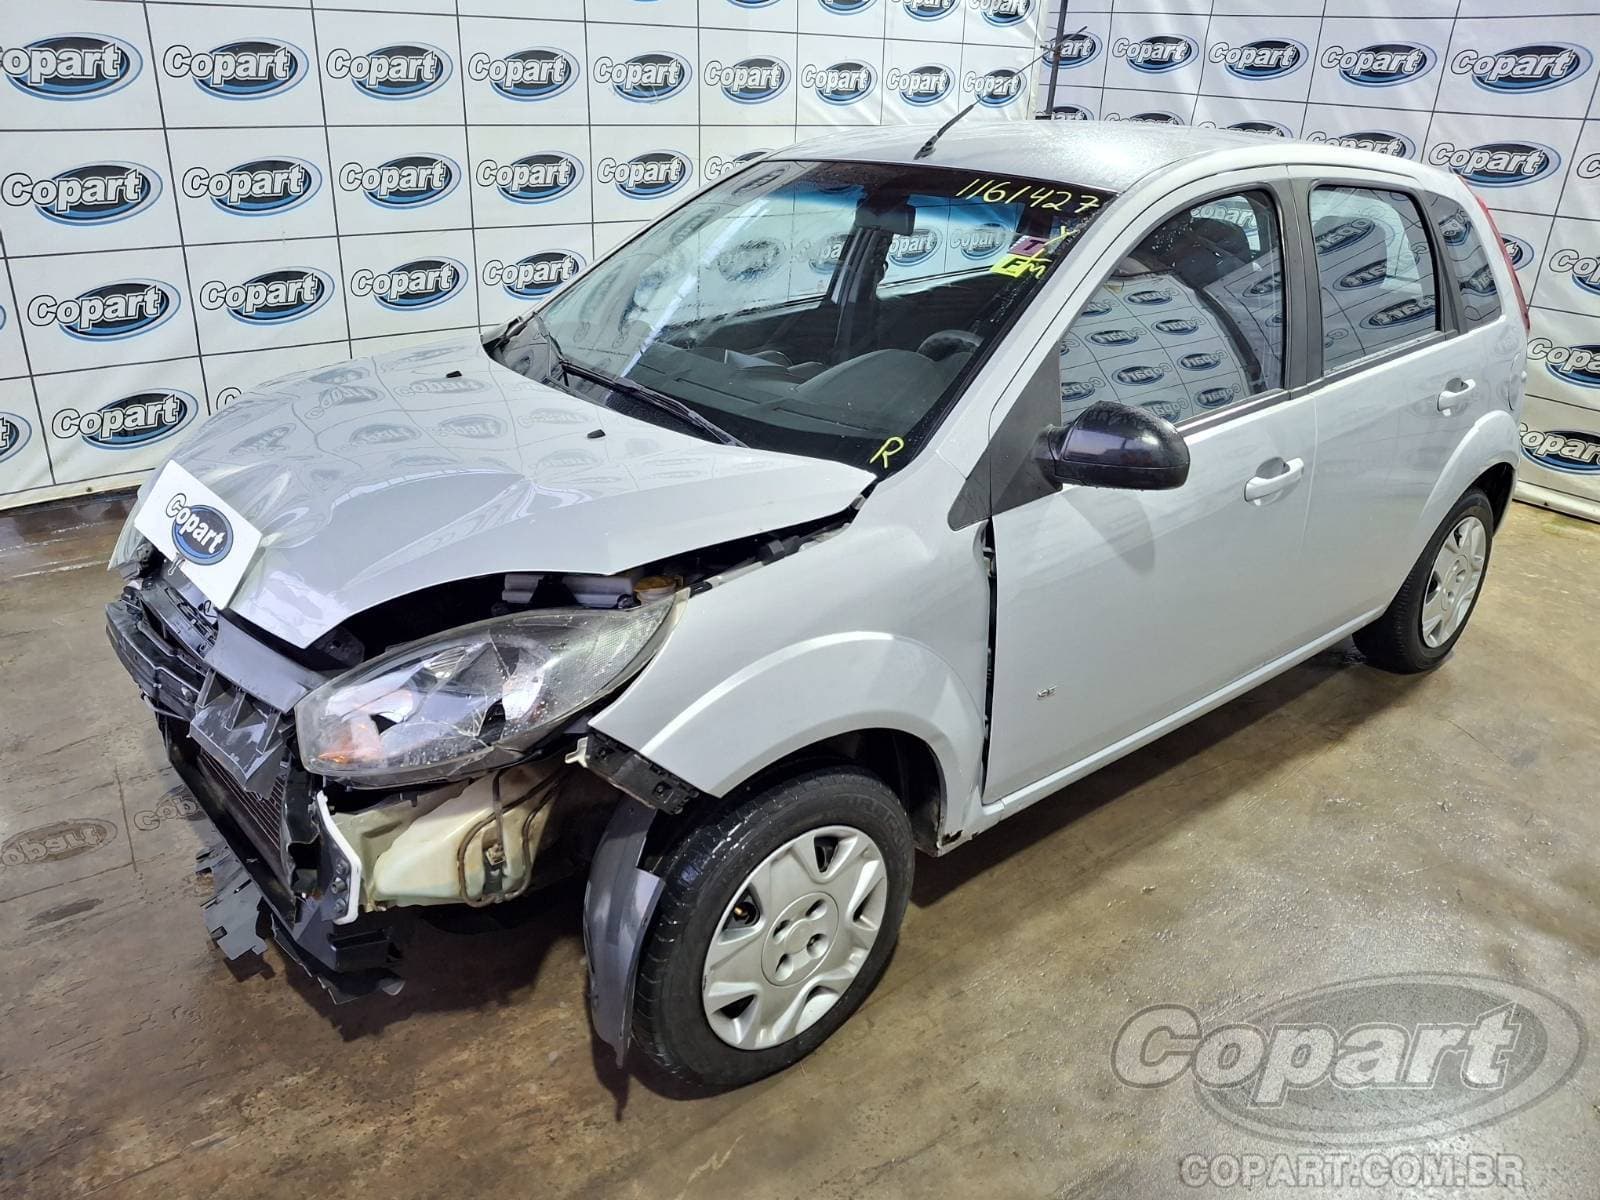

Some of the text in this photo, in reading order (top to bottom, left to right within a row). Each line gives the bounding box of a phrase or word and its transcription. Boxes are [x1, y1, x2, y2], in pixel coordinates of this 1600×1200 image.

[0, 43, 122, 85] opart
[163, 44, 290, 87] Copart
[326, 49, 437, 87] Copart
[1112, 38, 1188, 63] Copart
[1209, 43, 1297, 69] Copart
[1321, 46, 1425, 75] Copart
[1451, 49, 1576, 82] Copart
[468, 52, 567, 88] Copart
[594, 56, 679, 90] Copart
[704, 61, 781, 93] Copart
[801, 64, 869, 94] Copart
[886, 68, 948, 95] Copart
[963, 72, 1020, 96] Copart
[476, 157, 571, 193] Copart
[597, 155, 681, 190] Copart
[1429, 143, 1546, 175] Copart
[2, 170, 143, 213] Copart
[182, 164, 304, 205] Copart
[339, 160, 447, 199] Copart
[955, 178, 1100, 213] 1161427
[351, 262, 453, 303] Copart
[483, 255, 575, 289] Copart
[28, 285, 163, 331] Copart
[200, 271, 320, 314] Copart
[1527, 338, 1600, 374] Copa
[52, 394, 181, 443] Copart
[869, 436, 905, 468] R
[1519, 422, 1600, 464] opar
[166, 493, 226, 554] Copart
